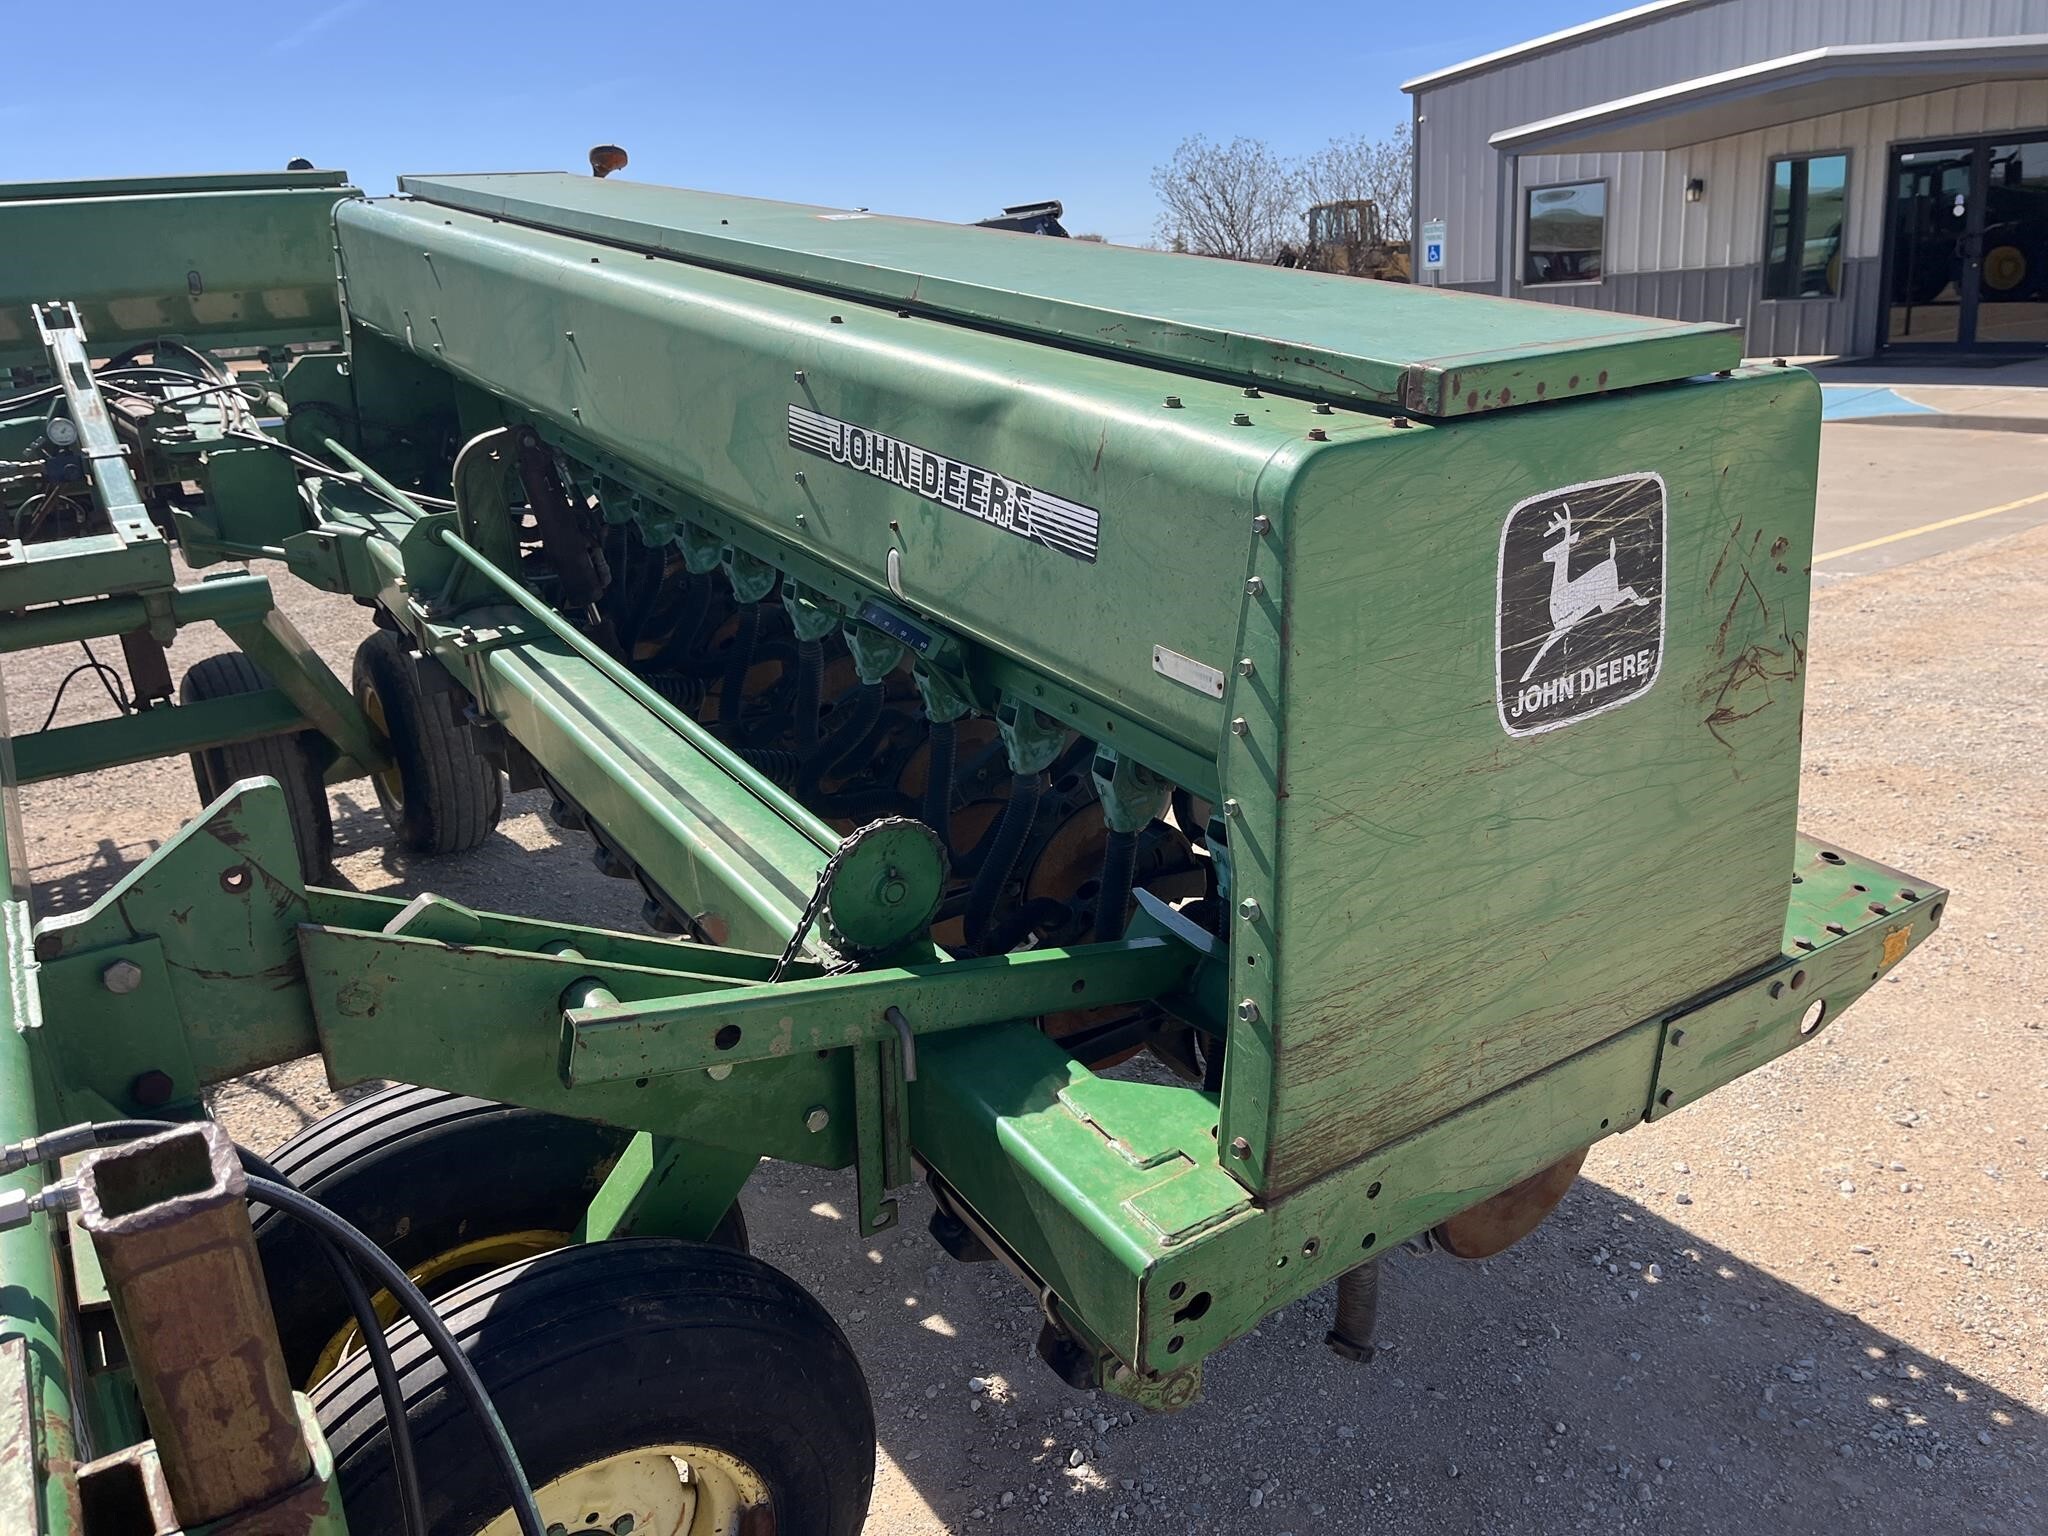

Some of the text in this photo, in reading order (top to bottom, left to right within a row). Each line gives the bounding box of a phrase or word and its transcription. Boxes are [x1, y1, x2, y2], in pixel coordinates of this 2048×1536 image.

[830, 423, 1032, 537] JOHN DEERE
[1511, 649, 1650, 717] JOHN DEERE
